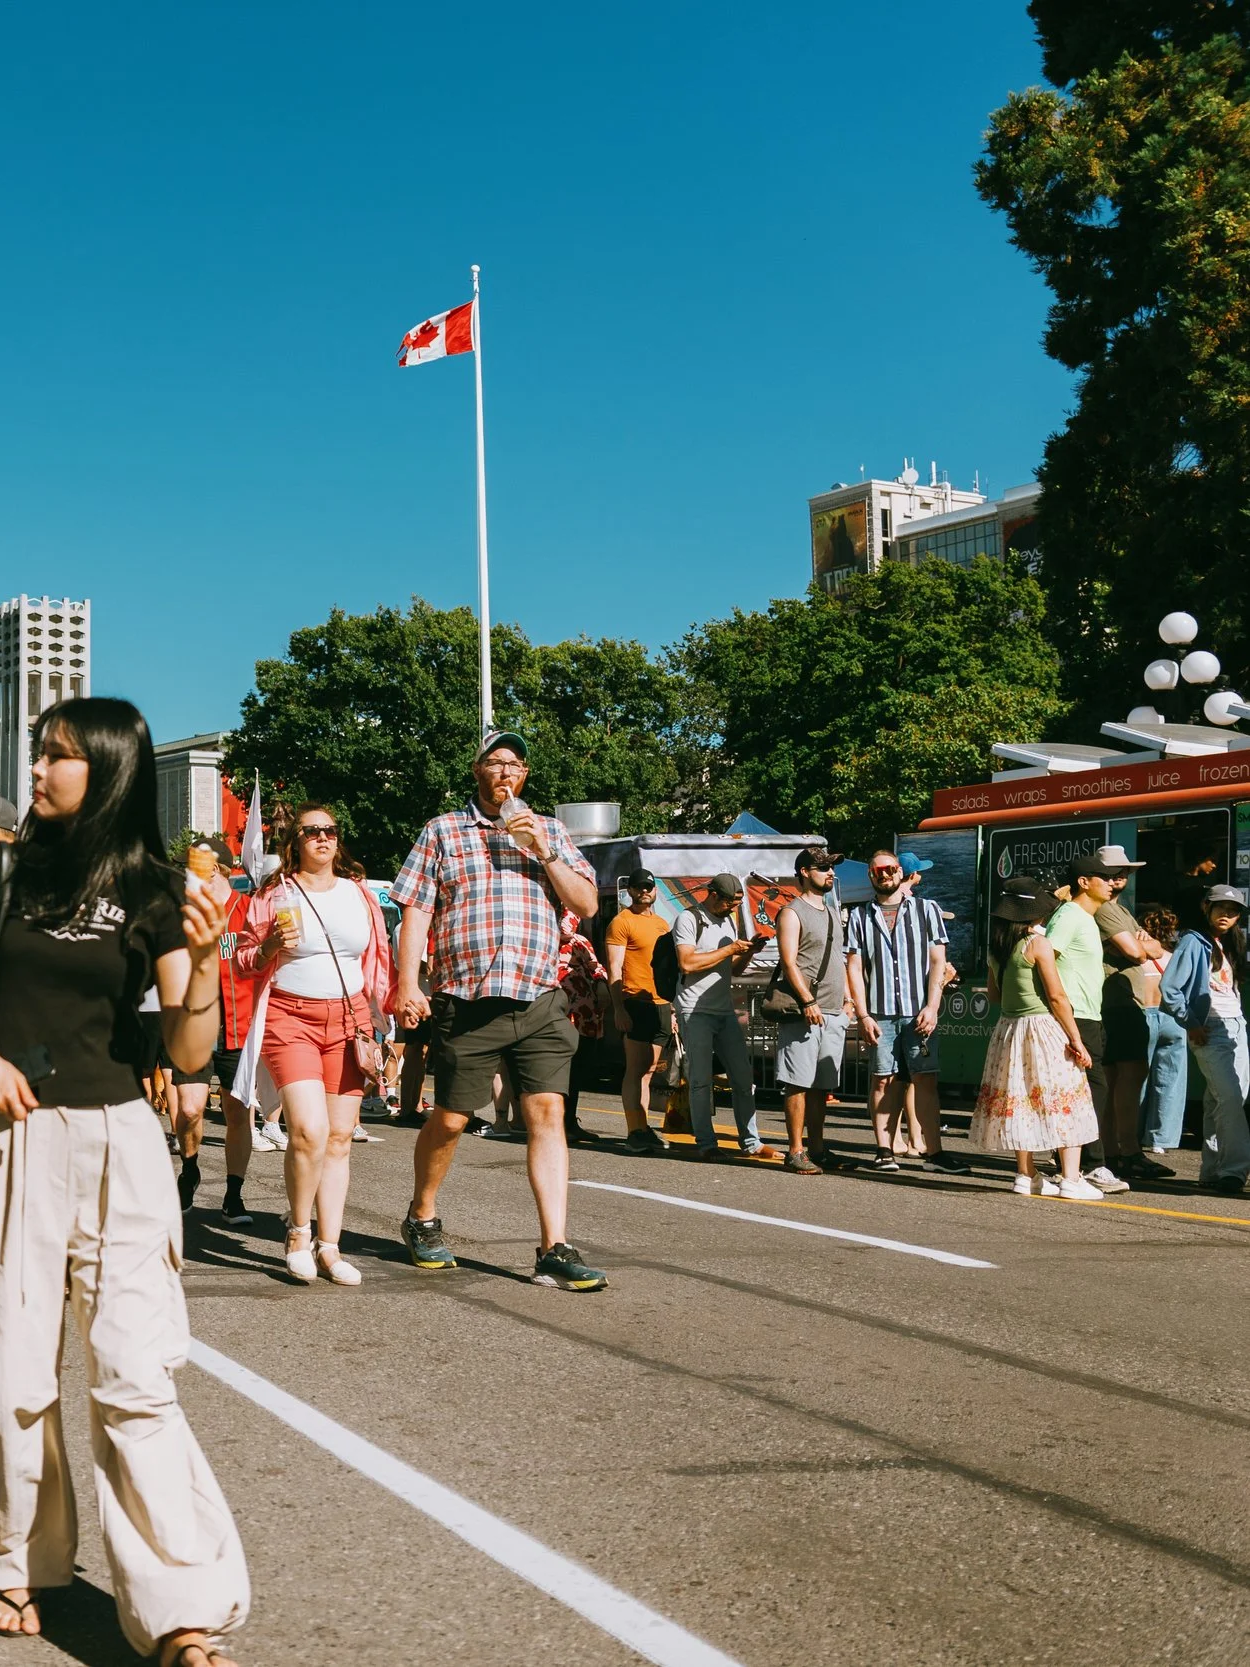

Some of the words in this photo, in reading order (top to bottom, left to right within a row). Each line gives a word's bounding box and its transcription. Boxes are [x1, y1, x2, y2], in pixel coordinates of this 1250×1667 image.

[952, 792, 990, 811] salads
[1003, 788, 1047, 805] wraps
[1062, 777, 1131, 799] smoothies
[1148, 771, 1180, 790] juice
[1200, 764, 1250, 783] frozen
[1013, 837, 1100, 865] FRESHCOAST
